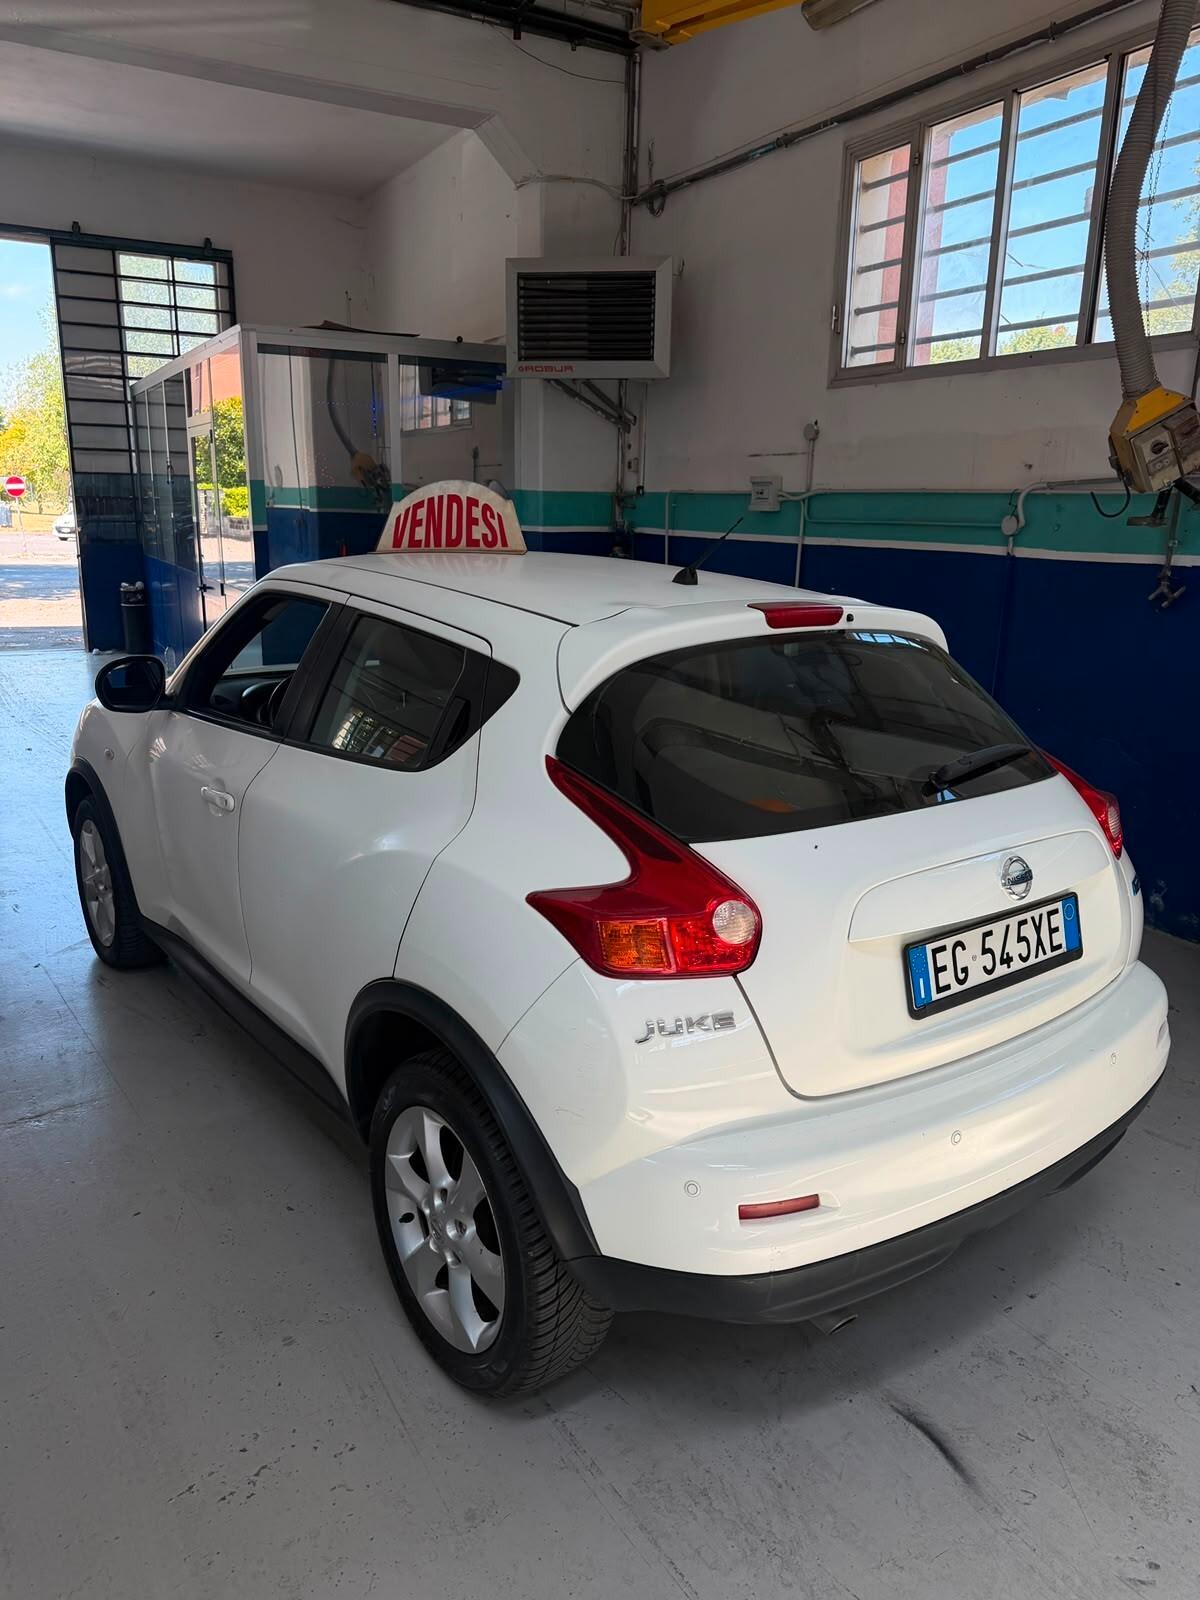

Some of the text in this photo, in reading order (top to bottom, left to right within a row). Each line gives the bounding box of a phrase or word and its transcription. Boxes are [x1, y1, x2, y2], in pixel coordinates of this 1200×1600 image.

[392, 494, 509, 548] VENDESI
[931, 908, 1064, 995] EG 545XE
[635, 1011, 737, 1044] JUKE
